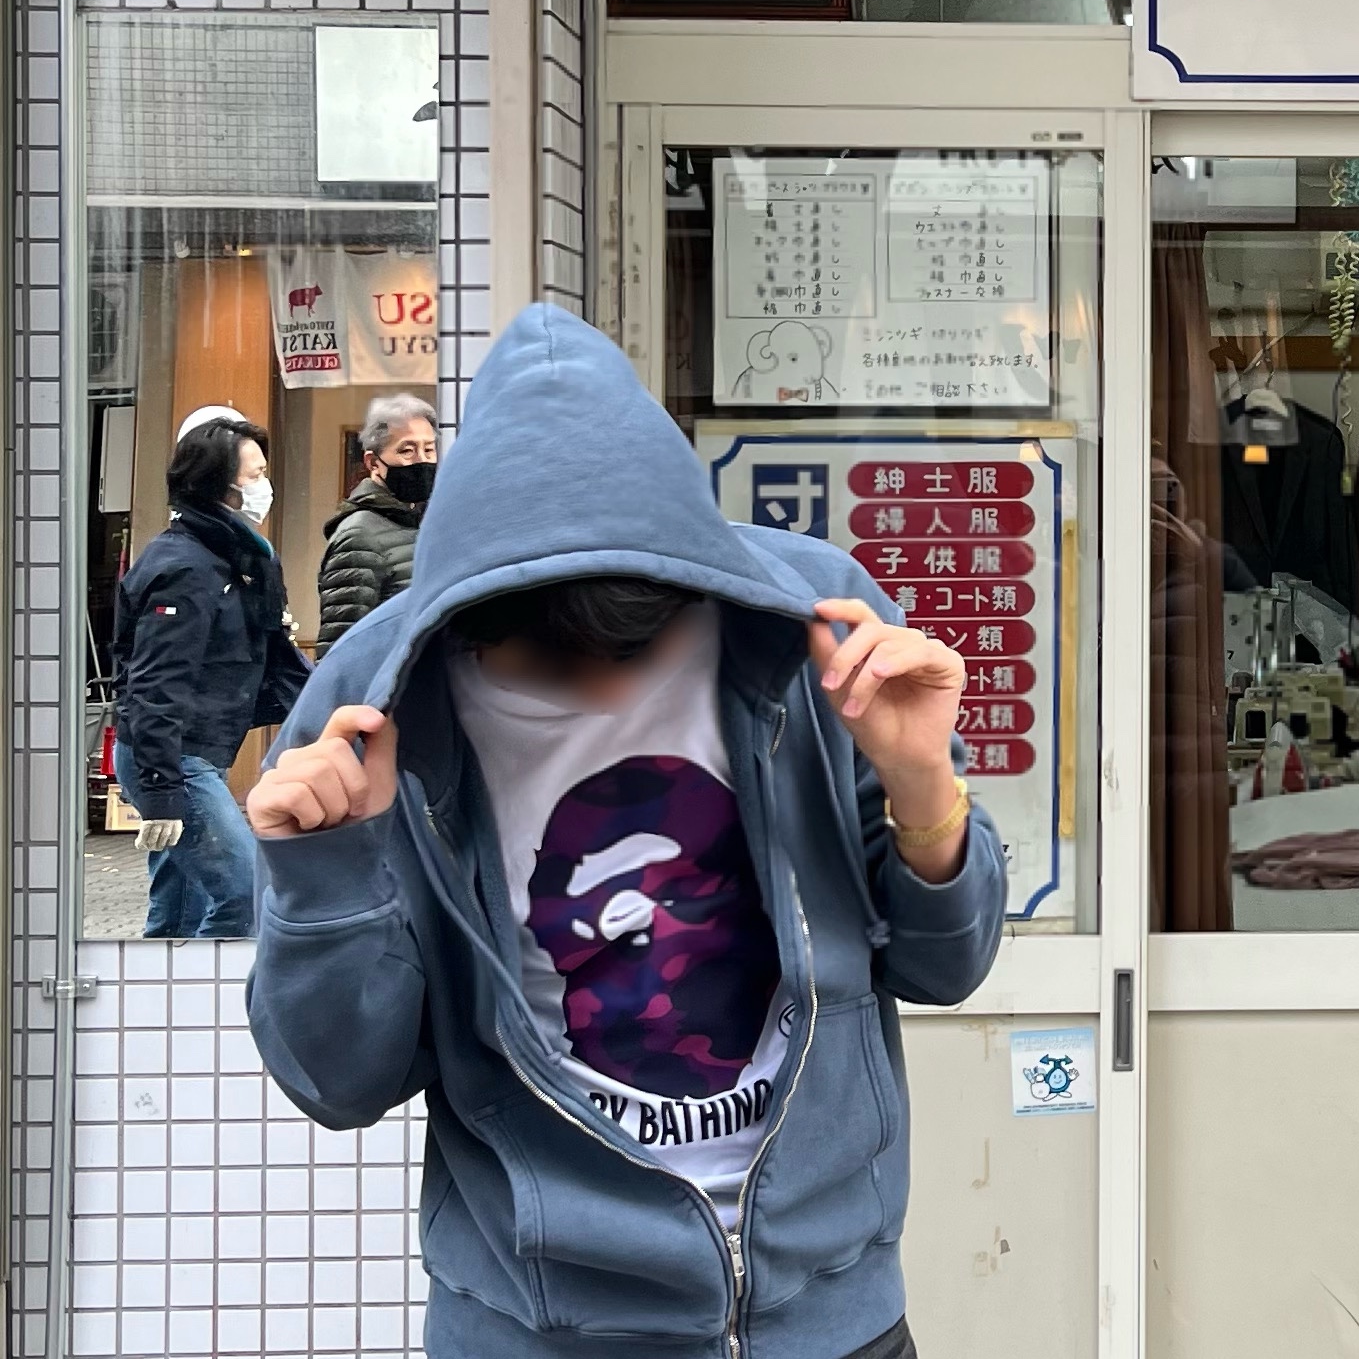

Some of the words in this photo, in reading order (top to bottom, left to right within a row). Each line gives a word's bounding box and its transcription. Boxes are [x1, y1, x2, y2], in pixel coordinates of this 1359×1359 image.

[873, 465, 999, 495] 紳士服
[873, 507, 1000, 534] 婦人服
[876, 546, 1002, 575] 子供服
[961, 666, 1016, 692] ート類
